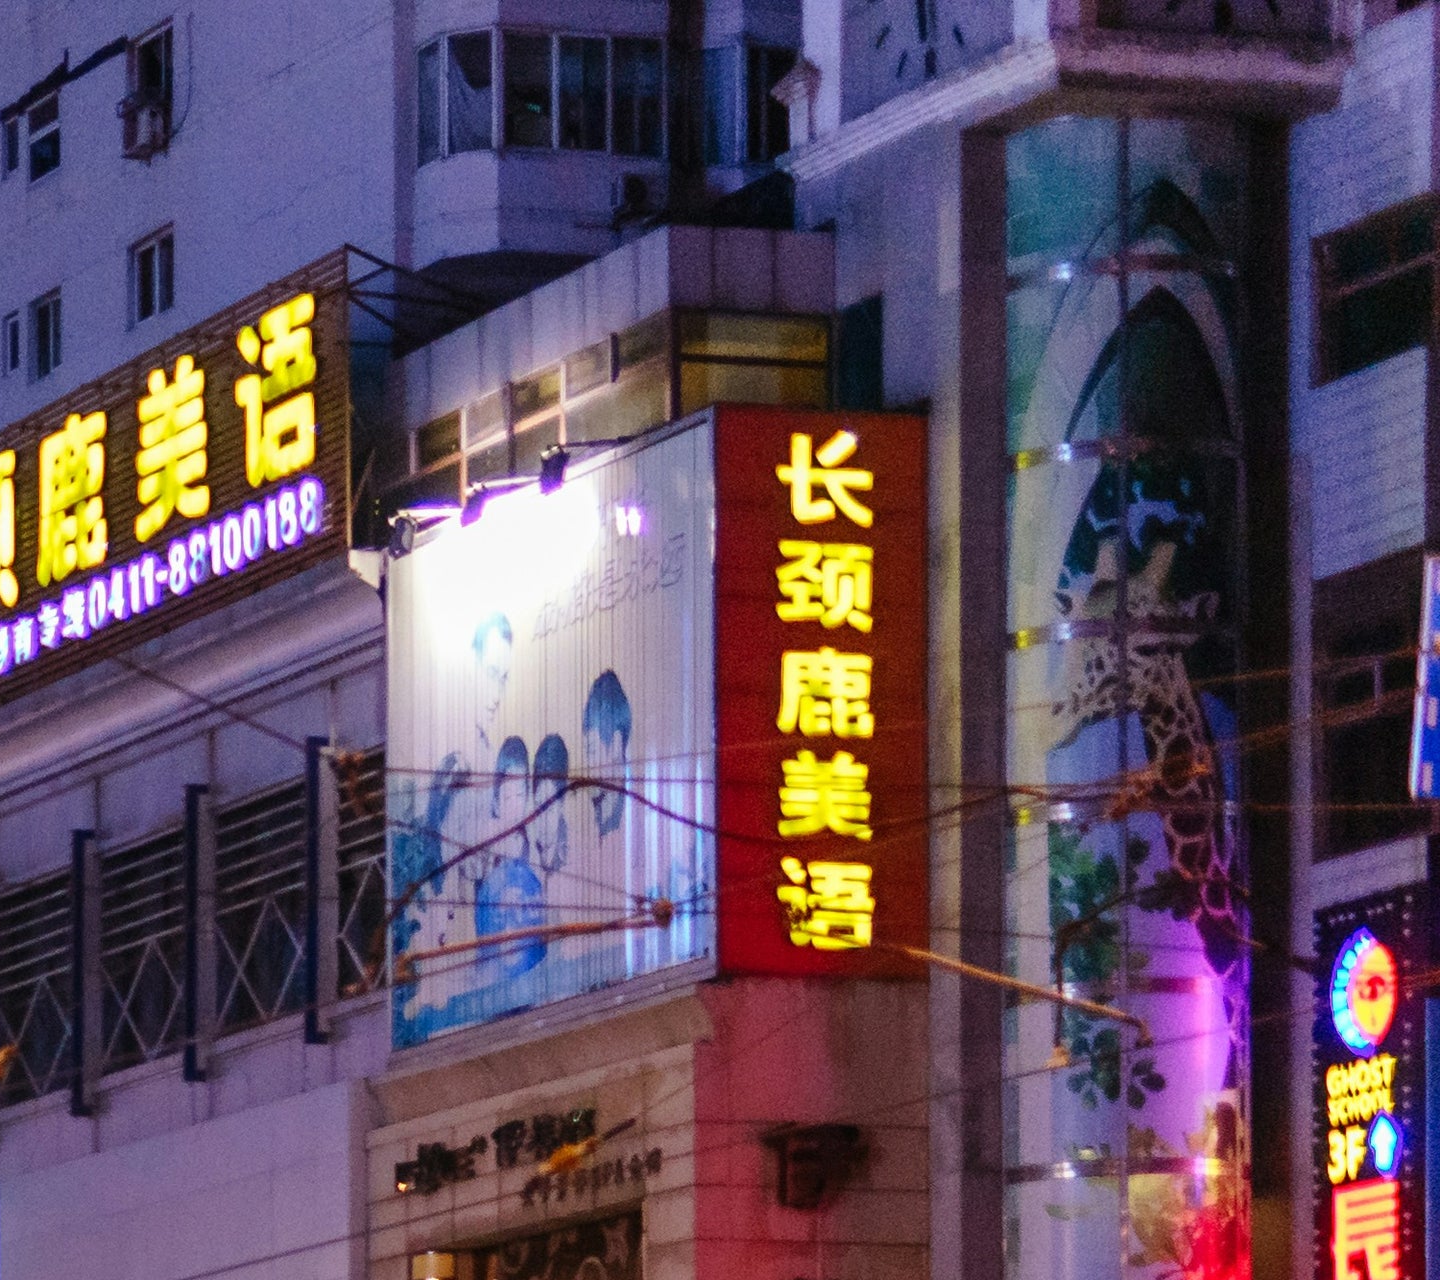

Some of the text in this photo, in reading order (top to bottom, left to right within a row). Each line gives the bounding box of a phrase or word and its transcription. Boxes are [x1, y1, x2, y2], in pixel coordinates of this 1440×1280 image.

[776, 431, 875, 951] 长颈鹿美语
[1327, 1056, 1396, 1097] GHOST
[1328, 1124, 1367, 1185] 3F
